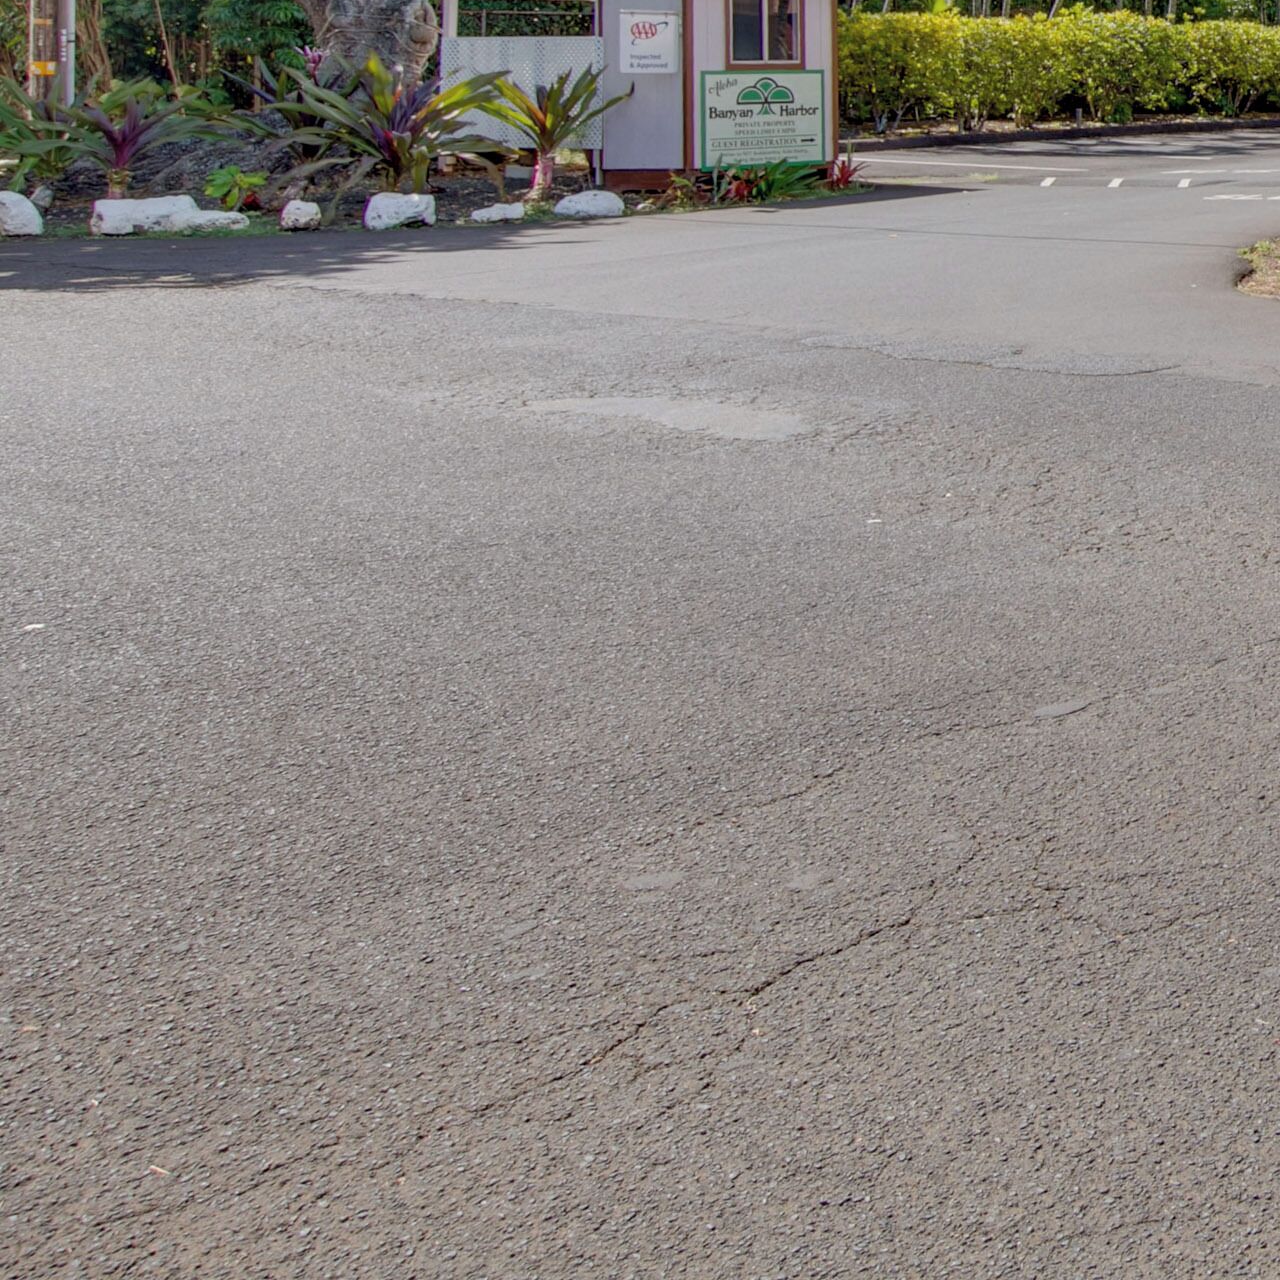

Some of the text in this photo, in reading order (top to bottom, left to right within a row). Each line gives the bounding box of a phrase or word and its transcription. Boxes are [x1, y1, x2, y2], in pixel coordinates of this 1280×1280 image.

[636, 62, 668, 70] Approved
[709, 105, 819, 120] Banyan Harbor
[734, 121, 760, 129] PRIVATE
[711, 138, 798, 148] GUEST REGISTRATION
